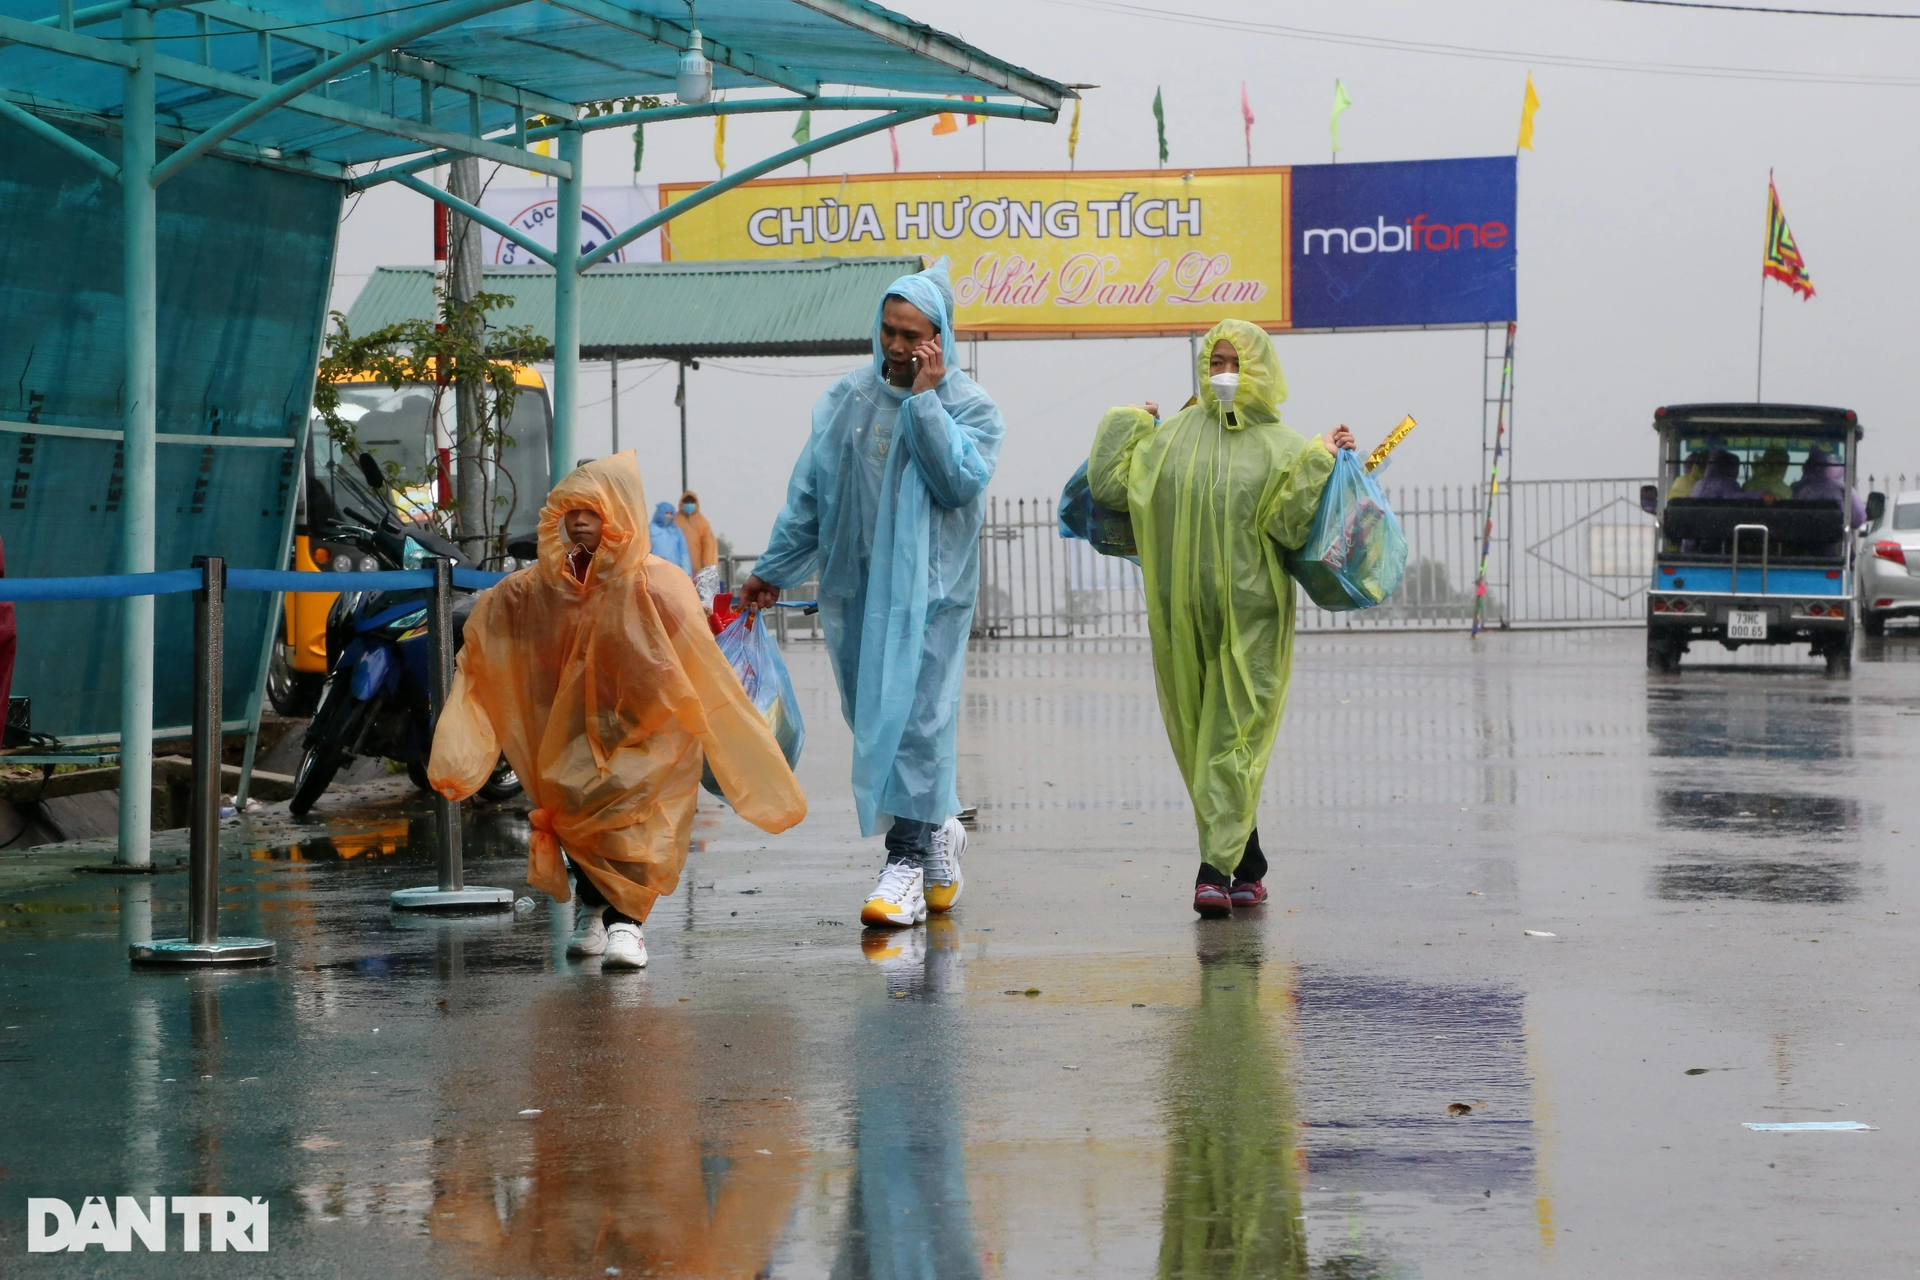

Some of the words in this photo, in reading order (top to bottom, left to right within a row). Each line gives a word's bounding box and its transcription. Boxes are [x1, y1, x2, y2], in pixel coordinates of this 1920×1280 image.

[523, 206, 555, 231] LỘC
[747, 198, 884, 246] CHÙA
[896, 194, 1080, 239] HƯƠNG
[1087, 192, 1202, 238] TÍCH
[1303, 214, 1508, 255] mobifone
[954, 251, 1052, 306] Nhất
[1055, 253, 1168, 306] Danh
[1166, 251, 1266, 304] Lam
[1731, 625, 1763, 637] 000.65
[1736, 613, 1759, 624] 73HC
